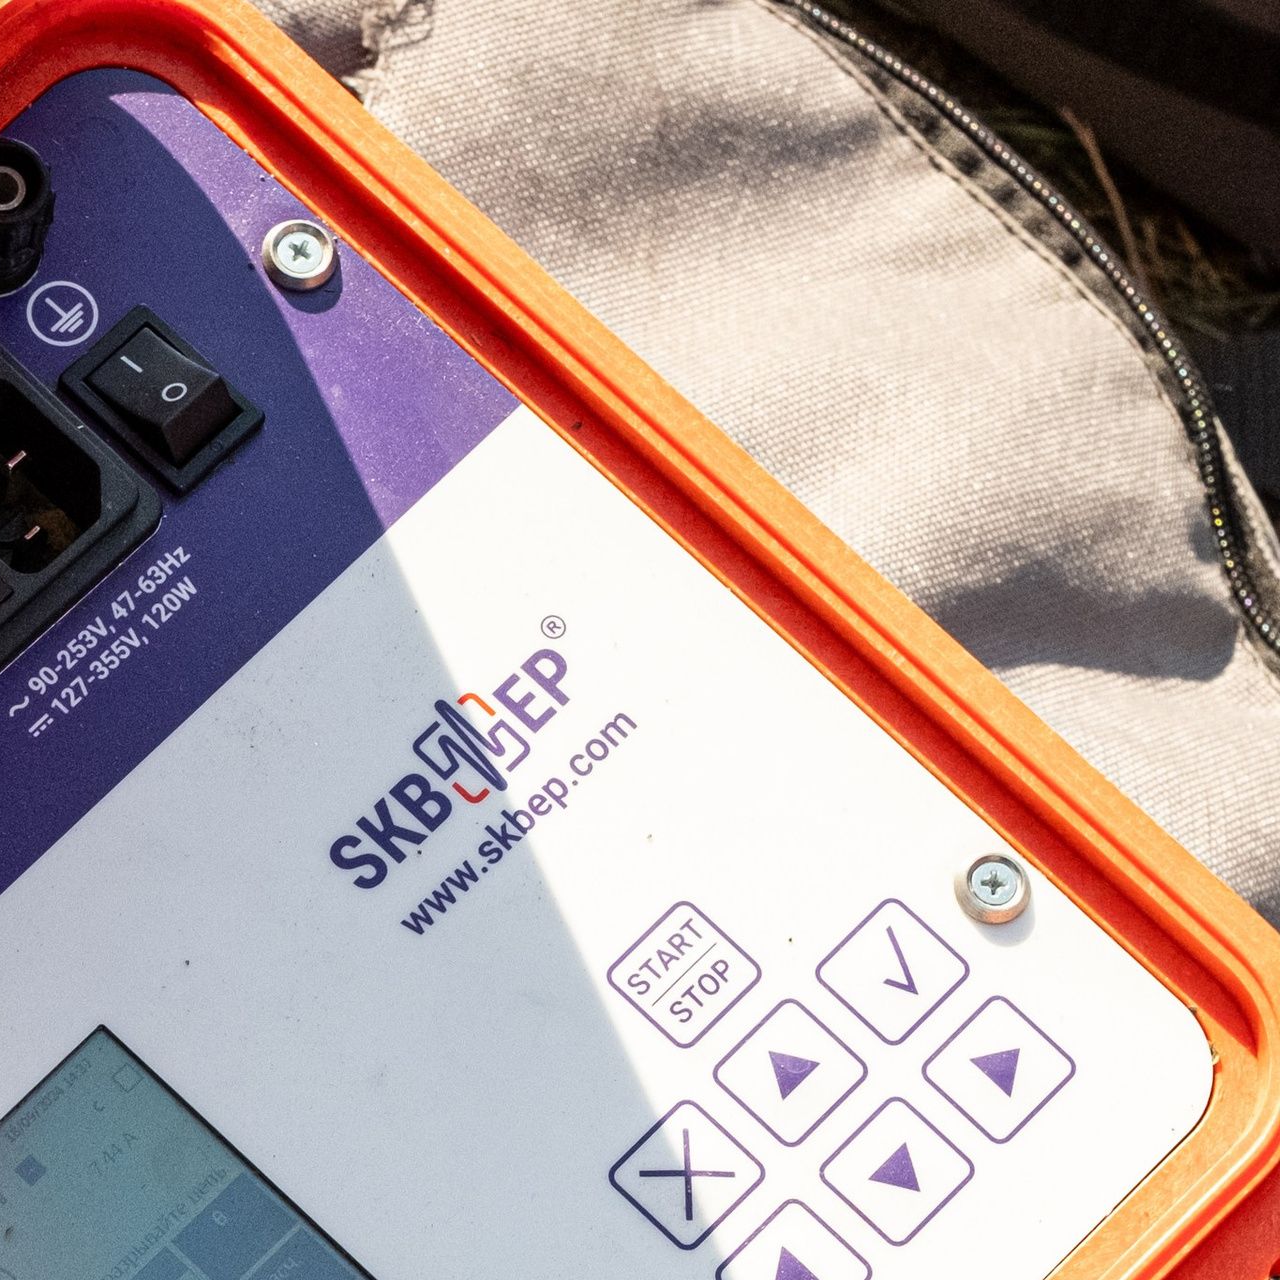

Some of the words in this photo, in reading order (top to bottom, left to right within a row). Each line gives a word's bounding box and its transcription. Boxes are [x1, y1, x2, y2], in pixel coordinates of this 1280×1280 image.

[27, 616, 117, 695] 90-253V,
[111, 546, 191, 620] 47-63Hz
[50, 627, 149, 714] 127-355V,
[141, 576, 198, 630] 120W
[400, 712, 637, 936] www.skbep.com
[626, 917, 704, 996] START
[669, 959, 730, 1024] STOP
